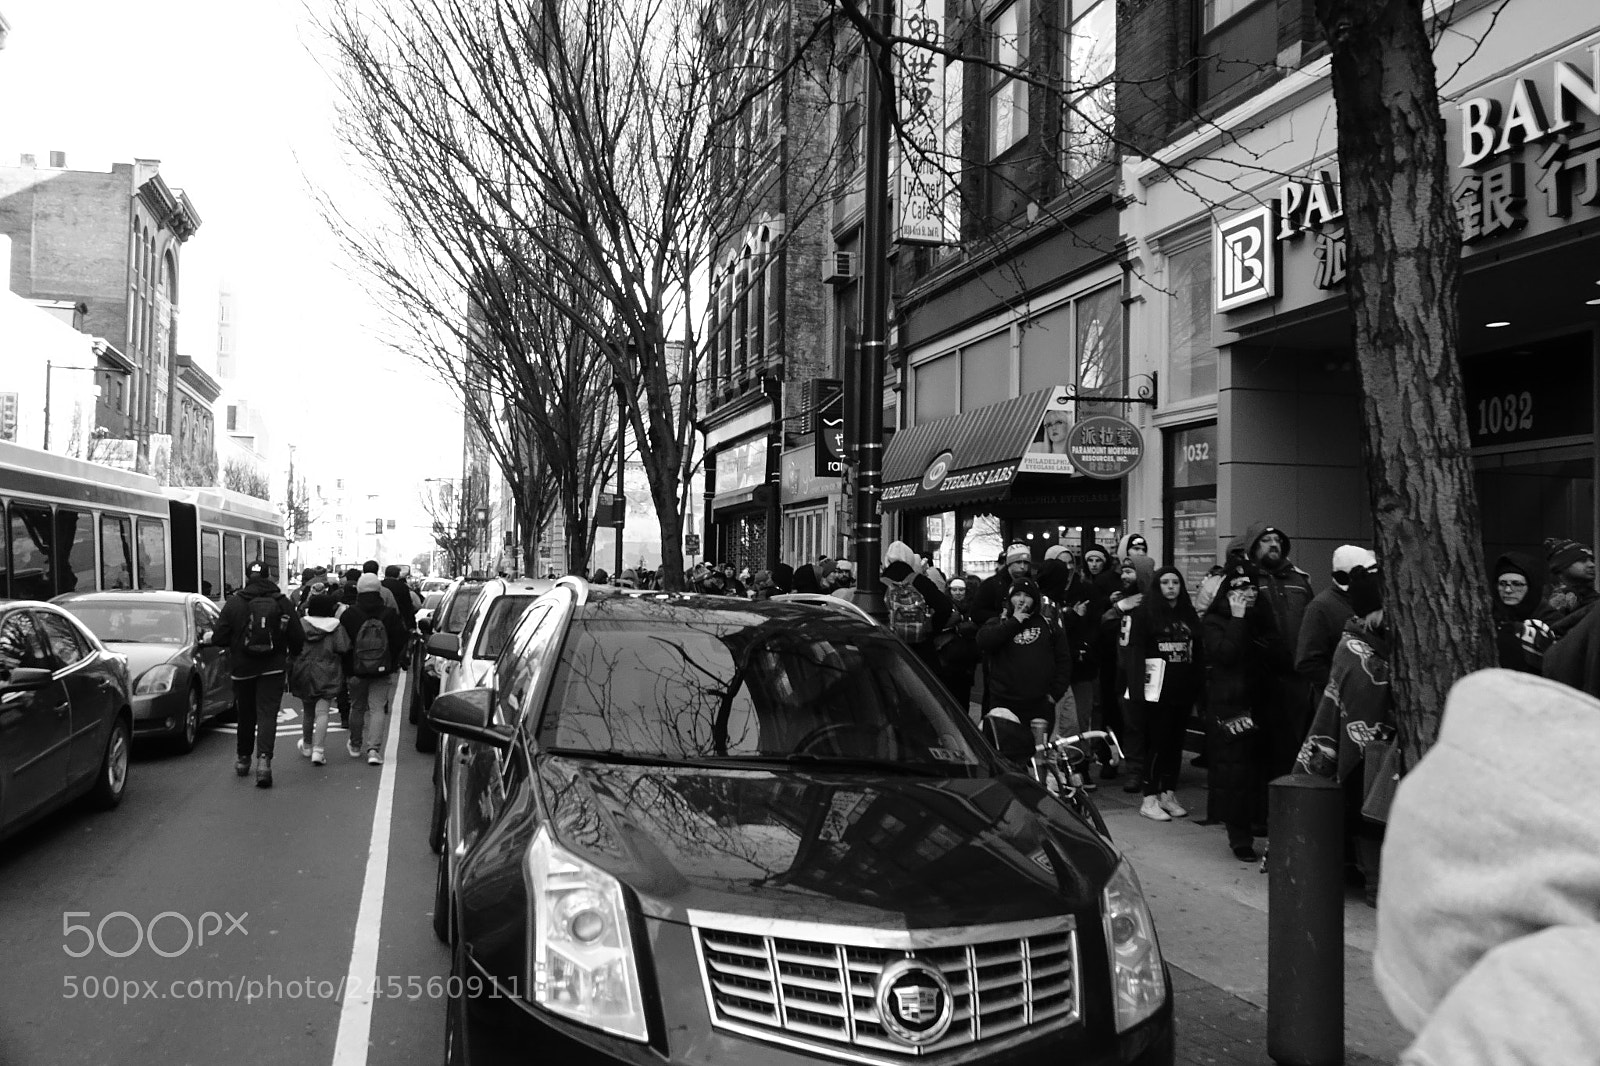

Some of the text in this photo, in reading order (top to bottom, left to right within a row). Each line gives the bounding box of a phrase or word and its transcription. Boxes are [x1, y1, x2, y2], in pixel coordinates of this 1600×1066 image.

[904, 176, 940, 199] Internet
[911, 201, 932, 221] Cafe
[1276, 162, 1343, 240] PA
[1478, 391, 1534, 435] 1032
[1071, 446, 1139, 456] PARAMOUNT MORTGAGE
[1183, 442, 1209, 462] 1032
[880, 465, 1016, 501] ADELPHIA EYEGLASS LABS
